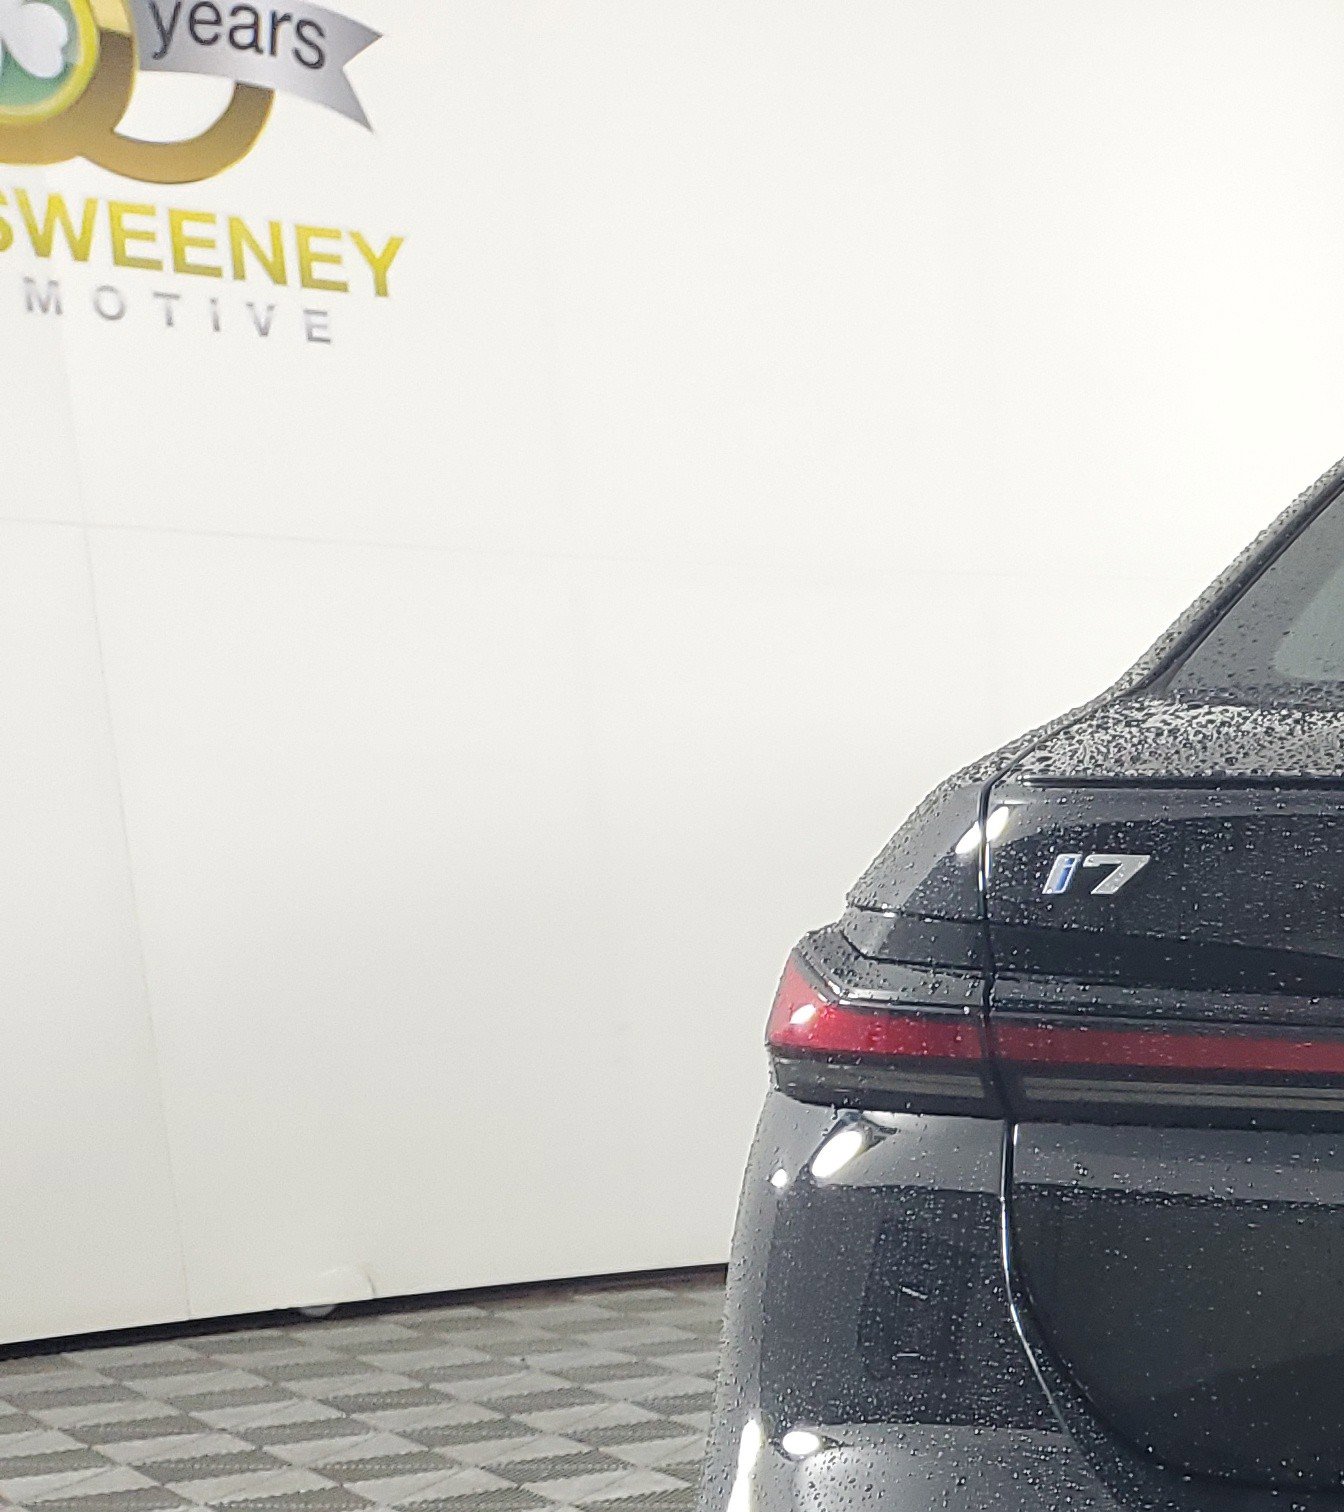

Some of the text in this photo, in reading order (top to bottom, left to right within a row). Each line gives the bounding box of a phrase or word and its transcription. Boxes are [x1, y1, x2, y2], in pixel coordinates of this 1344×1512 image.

[149, 0, 326, 71] years
[0, 187, 404, 297] WEENEY
[1042, 853, 1151, 895] i7
